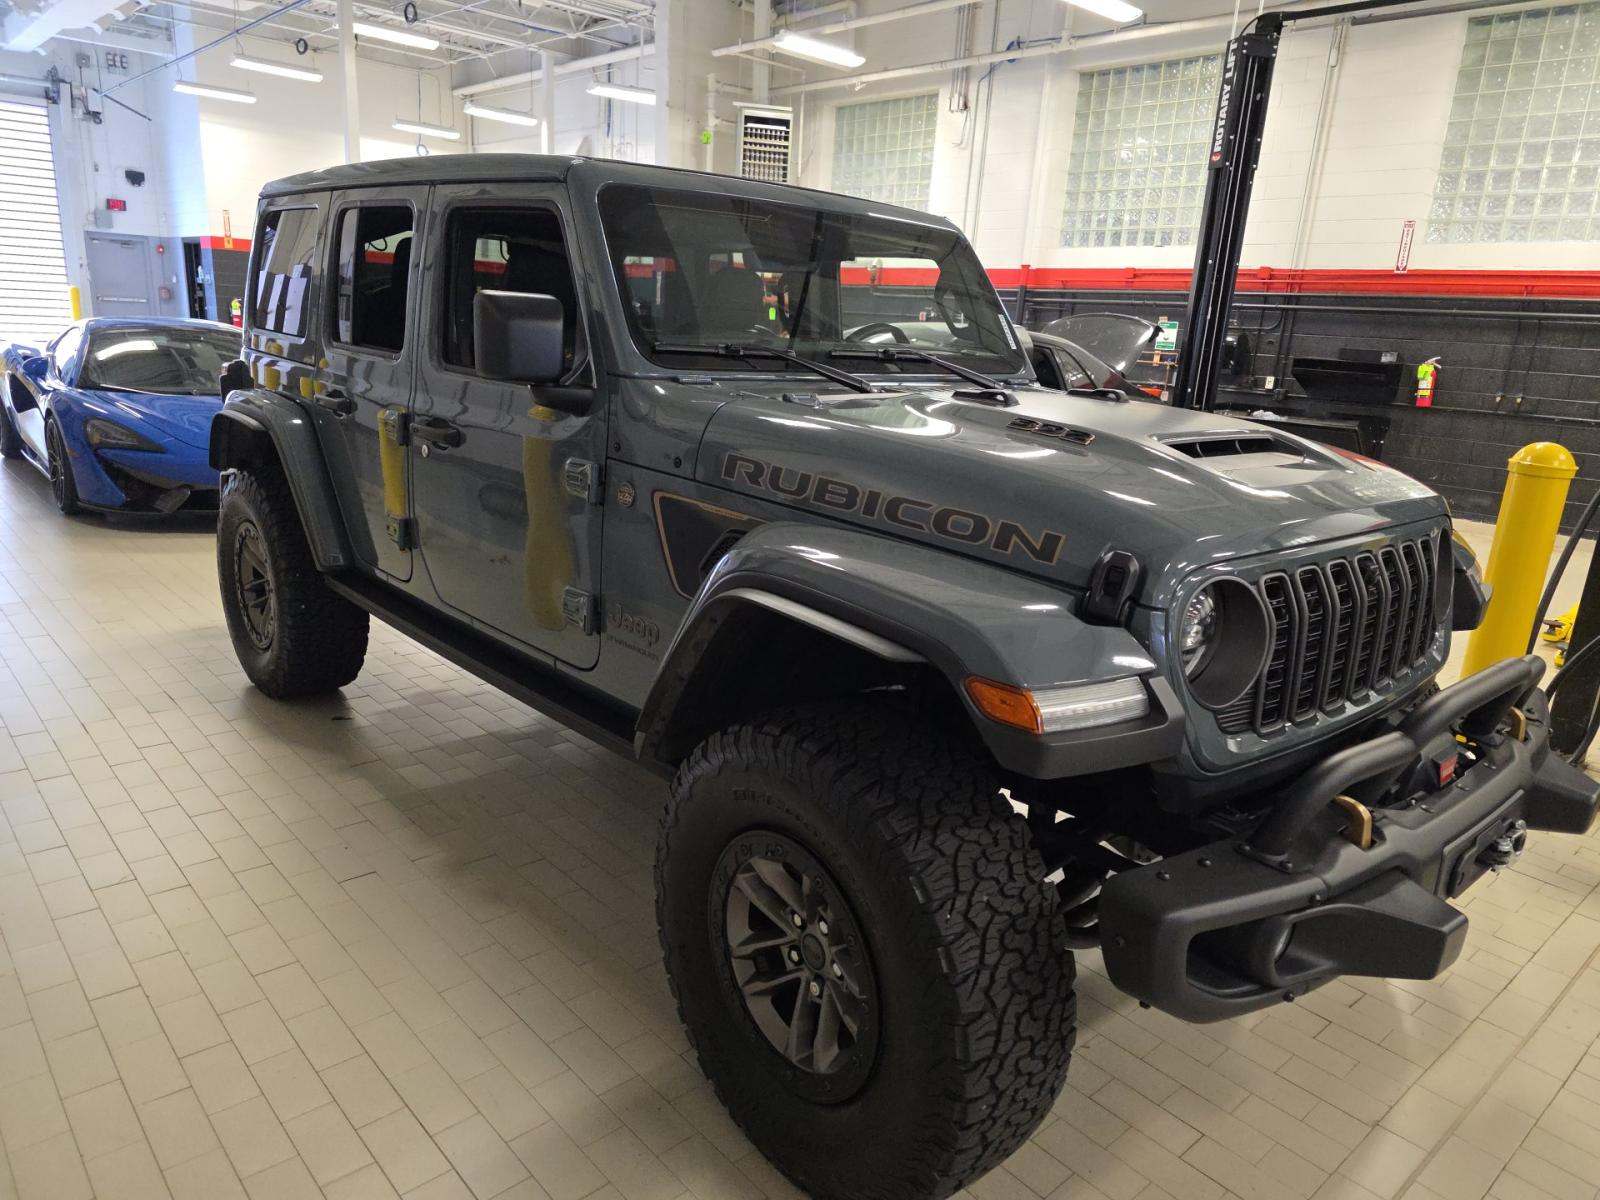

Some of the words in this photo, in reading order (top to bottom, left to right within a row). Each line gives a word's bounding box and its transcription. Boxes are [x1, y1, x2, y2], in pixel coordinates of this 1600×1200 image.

[1213, 84, 1231, 153] ROTARY
[1225, 40, 1238, 79] LIFT
[721, 452, 1066, 565] RUBICON
[608, 602, 660, 648] Jeep
